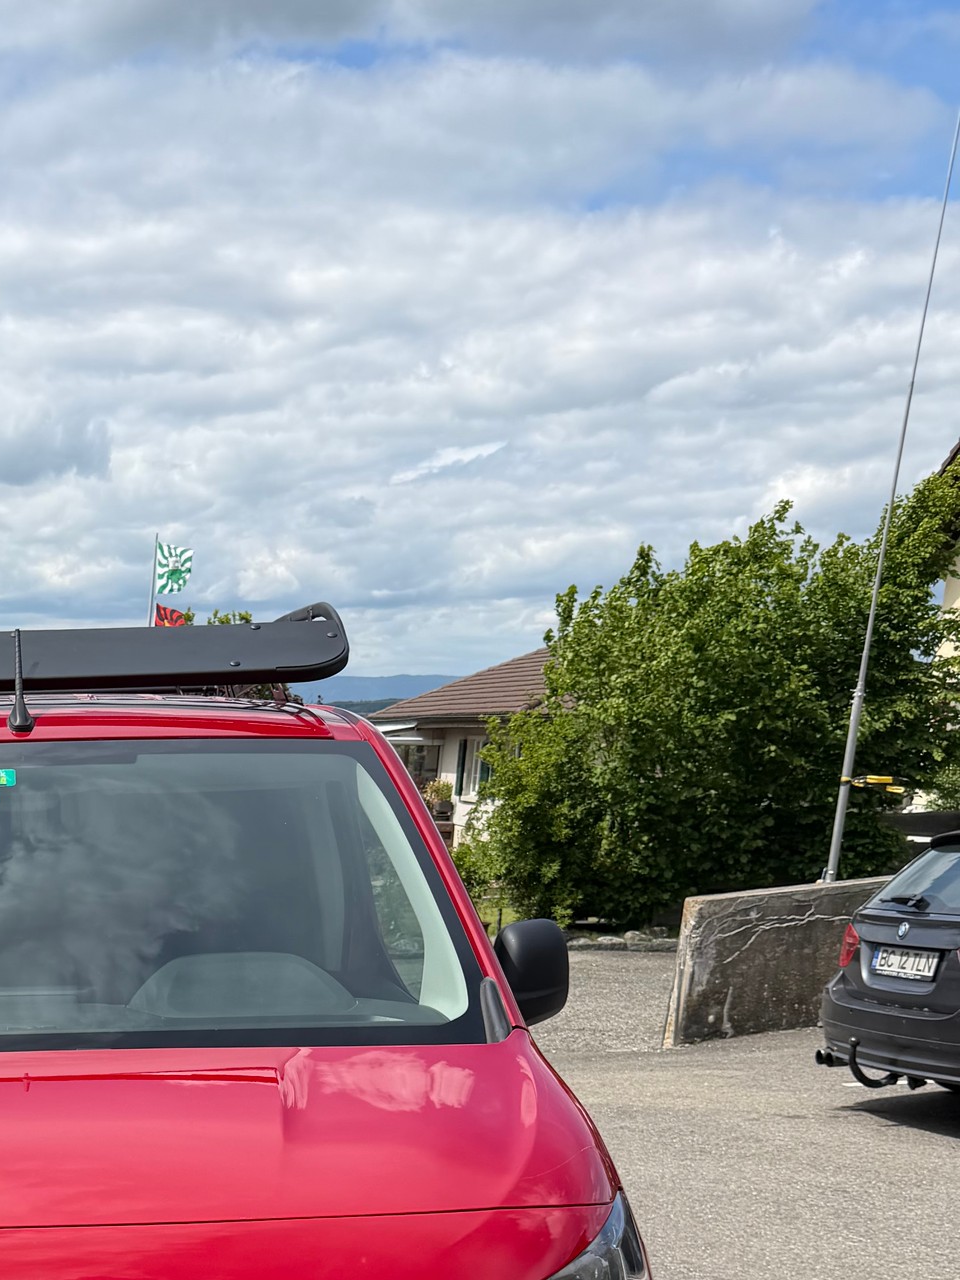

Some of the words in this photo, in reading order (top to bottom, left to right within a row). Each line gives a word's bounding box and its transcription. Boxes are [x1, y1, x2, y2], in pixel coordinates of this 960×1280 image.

[879, 949, 896, 968] BC
[898, 950, 910, 970] 12
[911, 952, 936, 974] TLN
